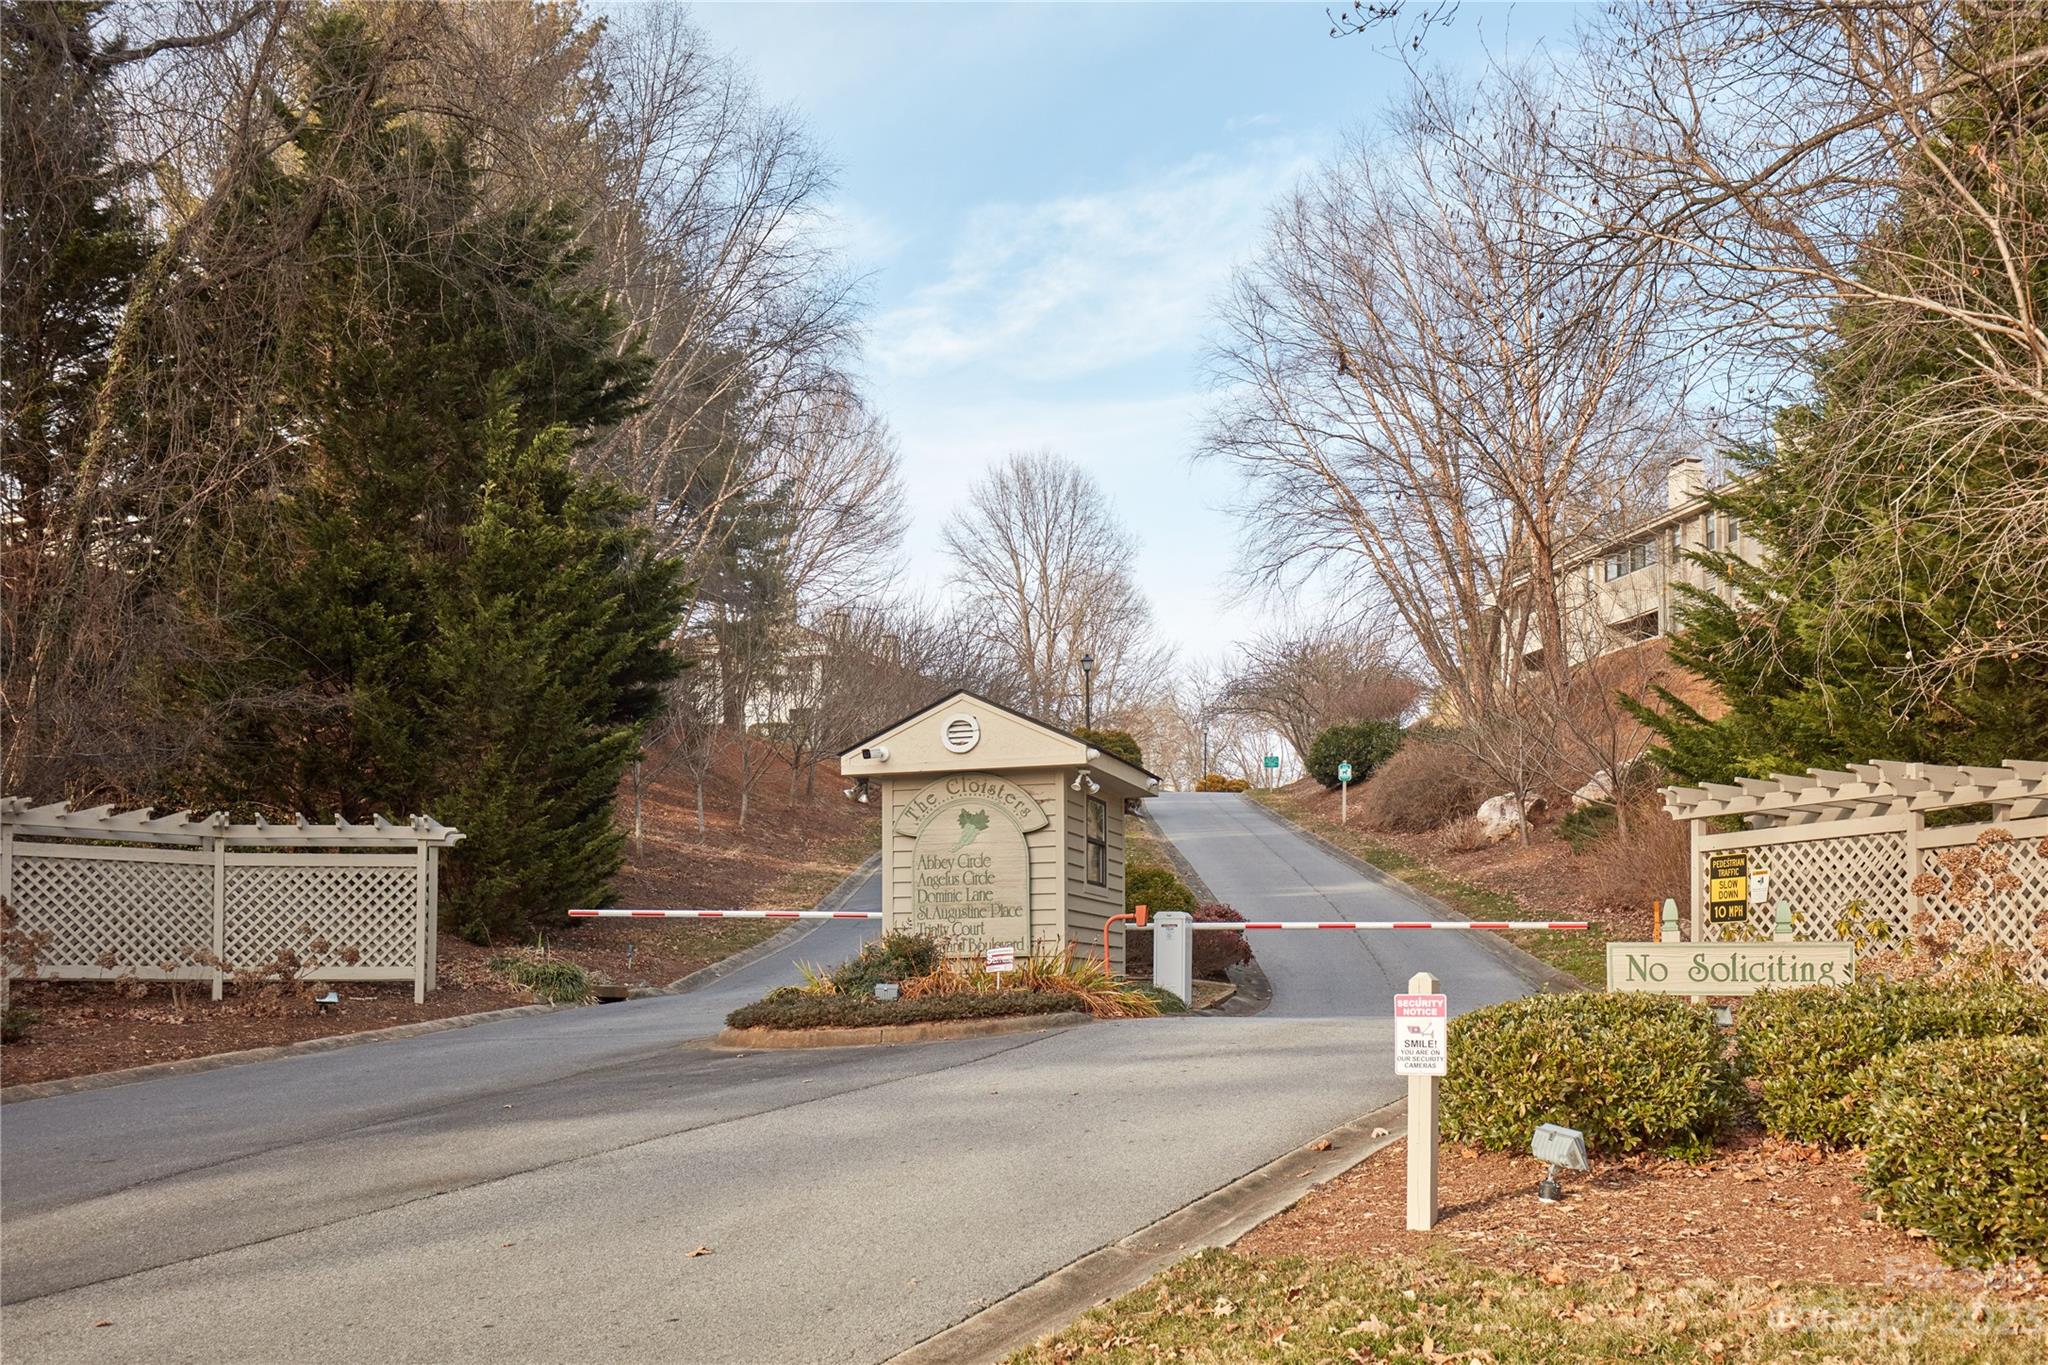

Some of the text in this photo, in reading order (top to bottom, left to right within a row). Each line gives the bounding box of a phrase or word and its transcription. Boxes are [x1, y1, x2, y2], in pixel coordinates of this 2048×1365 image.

[904, 776, 1032, 821] The Cloisters
[917, 852, 992, 872] Abbey Circle
[1712, 858, 1745, 868] PEDESTRIAN
[1718, 868, 1740, 877] TRAFFIC
[917, 870, 995, 890] Angelus Circle
[1719, 880, 1738, 889] SLOW
[917, 887, 994, 904] Dominic Lane
[1718, 890, 1739, 899] DOWN
[932, 904, 988, 924] Augustine
[990, 903, 1023, 918] Place
[1714, 905, 1744, 918] 10 MPH
[952, 921, 986, 936] Court
[1625, 952, 1836, 989] No Soliciting
[1397, 999, 1444, 1008] SECURITY
[1403, 1008, 1438, 1016] NOTICE
[1404, 1039, 1438, 1048] SMILE!
